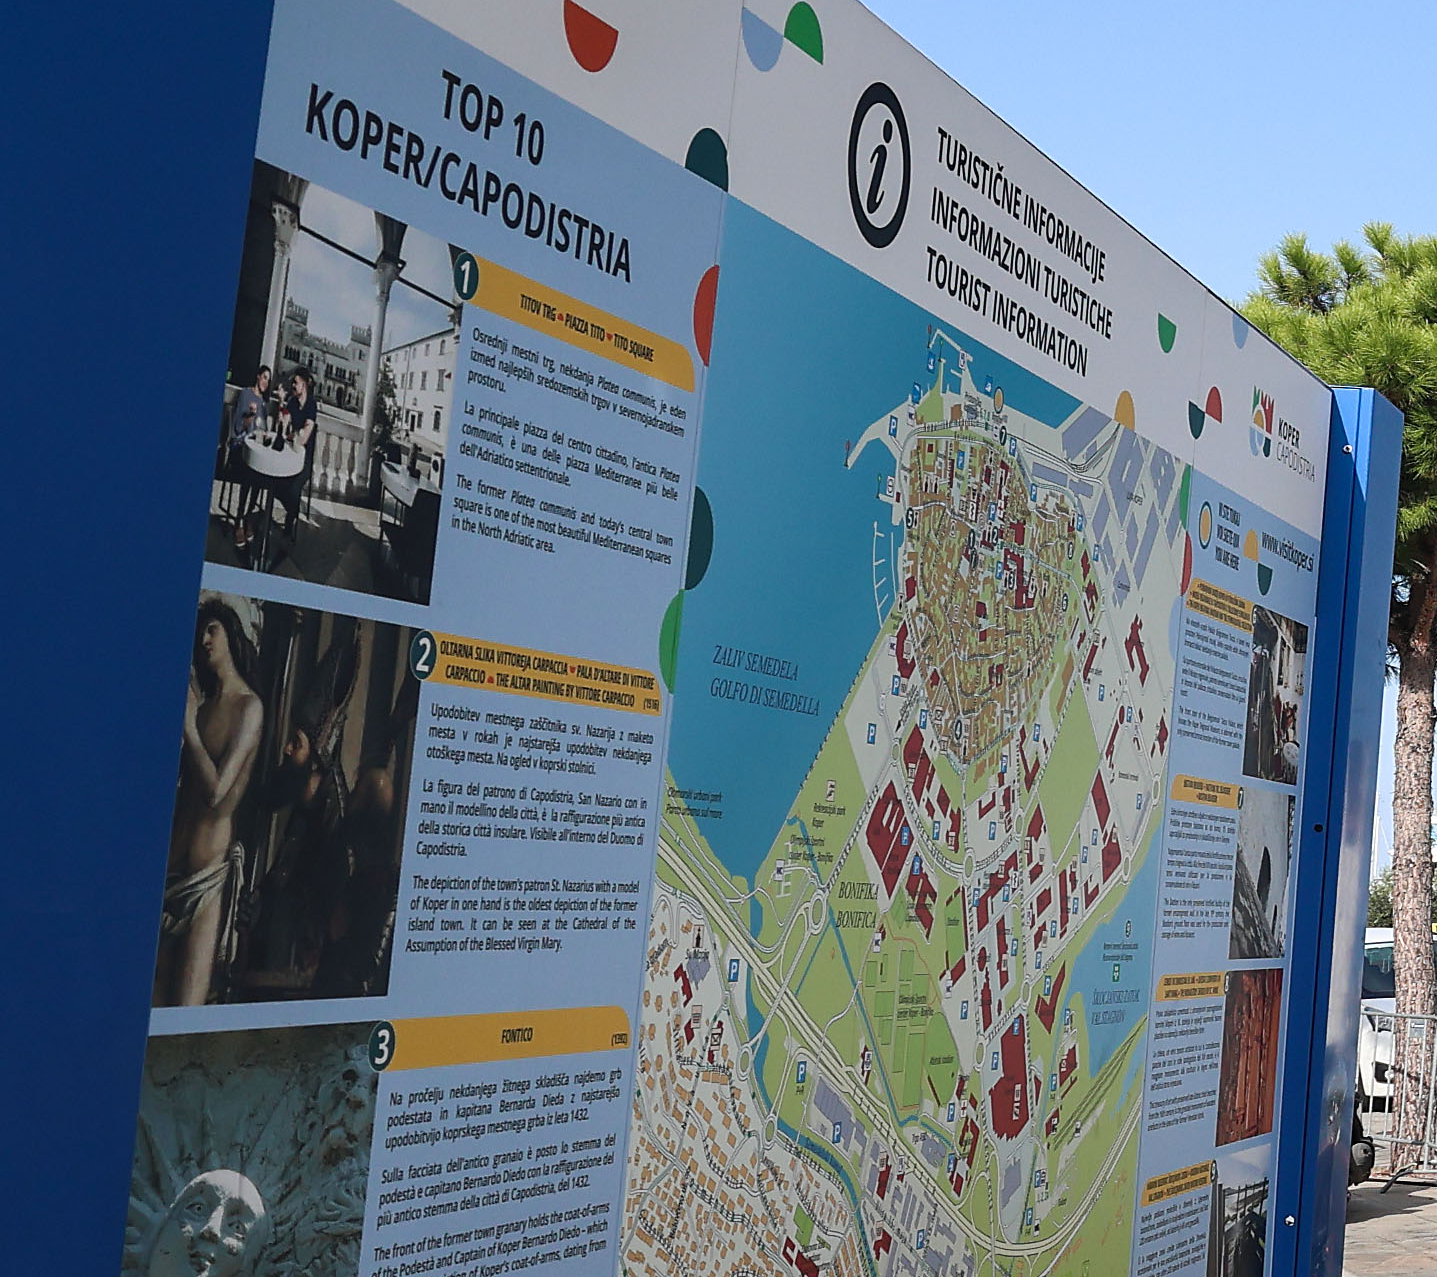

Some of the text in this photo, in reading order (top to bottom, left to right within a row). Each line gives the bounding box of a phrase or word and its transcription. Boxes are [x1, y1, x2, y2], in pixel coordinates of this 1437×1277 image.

[440, 70, 546, 167] TOP 10
[305, 83, 633, 284] KOPER/CAPODISTRIA
[937, 126, 1107, 283] TURISTIČNE INFORMACIJE
[931, 188, 1113, 340] INFORMAZIONI TURISTICHE
[519, 293, 655, 362] TITOV TRG PIAZZA TITO TITO SQUARE
[926, 246, 1088, 377] TOURIST INFORMATION
[1277, 418, 1300, 450] KOPER
[1276, 447, 1316, 483] CAPODISTRIA
[1261, 531, 1315, 573] www.visitkoper.si
[711, 643, 798, 681] ZALIV SEMEDELA
[709, 675, 820, 716] GOLFO DI SEMEDELLA
[838, 880, 880, 901] BONIFIKA
[835, 909, 878, 930] BONIFICA
[500, 1026, 533, 1044] FONTICO
